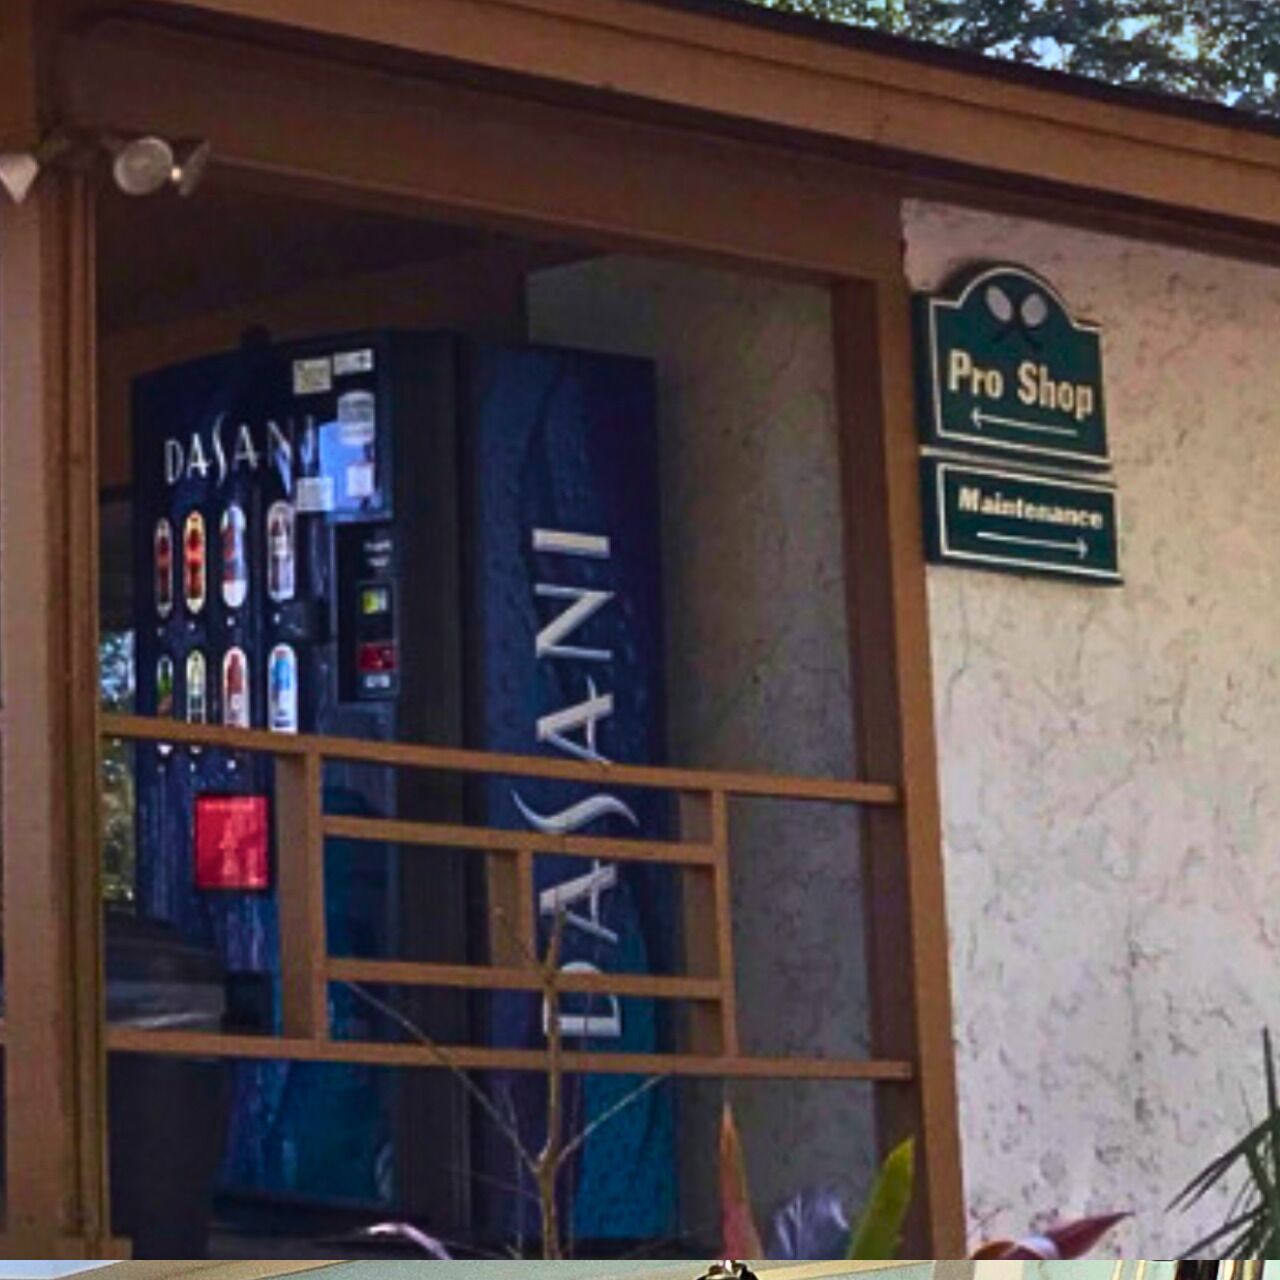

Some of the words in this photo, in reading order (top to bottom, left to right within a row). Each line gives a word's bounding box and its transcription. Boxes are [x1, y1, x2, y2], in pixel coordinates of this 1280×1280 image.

[947, 349, 1004, 400] Pro
[1016, 360, 1095, 421] Shop
[957, 486, 1104, 531] Maintenance
[513, 528, 638, 1038] DASANI
